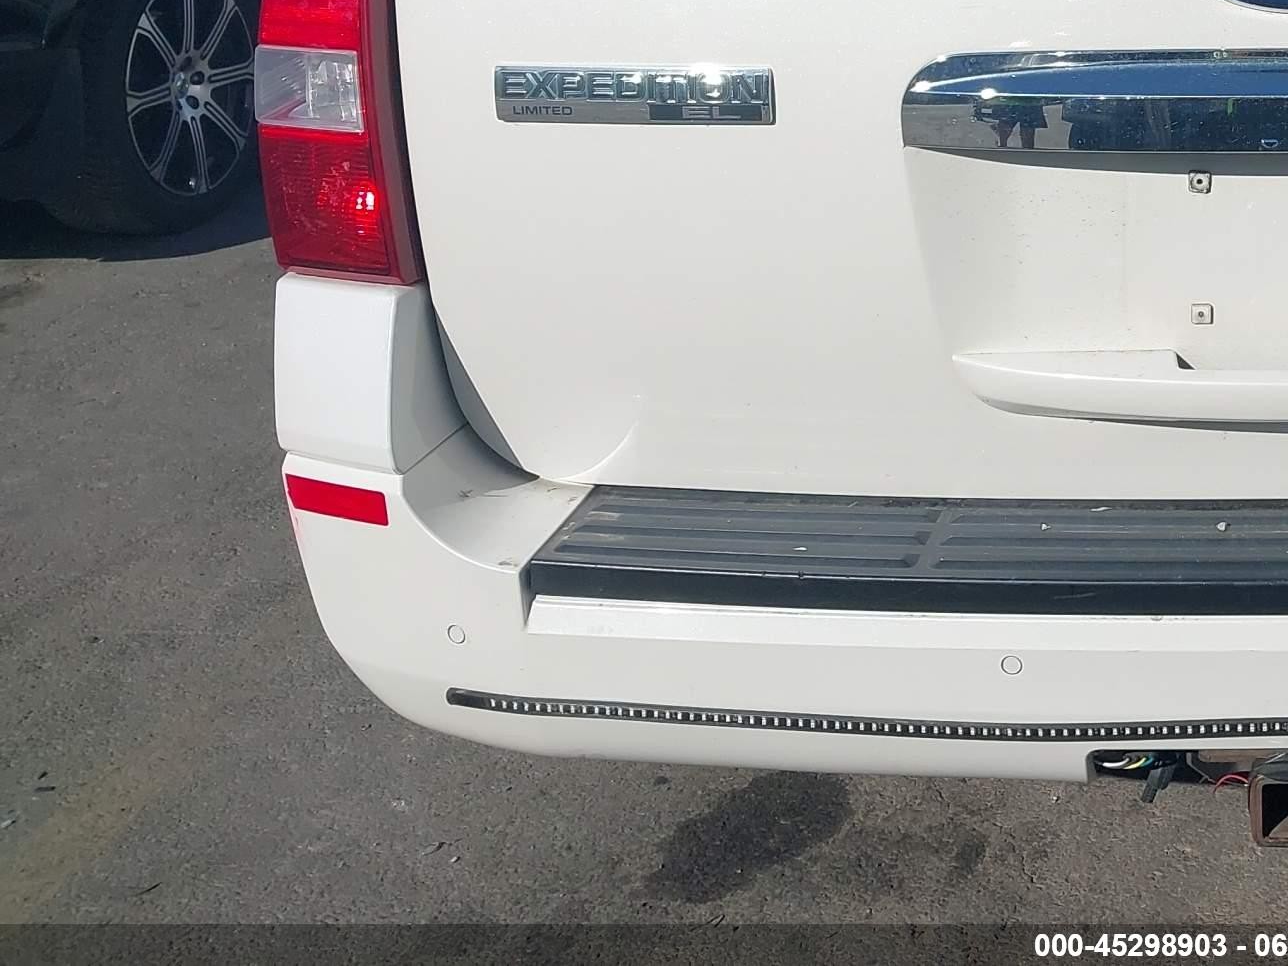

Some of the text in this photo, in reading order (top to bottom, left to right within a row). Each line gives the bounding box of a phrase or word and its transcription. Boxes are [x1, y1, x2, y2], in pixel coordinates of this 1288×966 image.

[500, 70, 768, 103] EXPEDITION
[512, 105, 574, 116] LIMITED
[682, 106, 742, 120] EL
